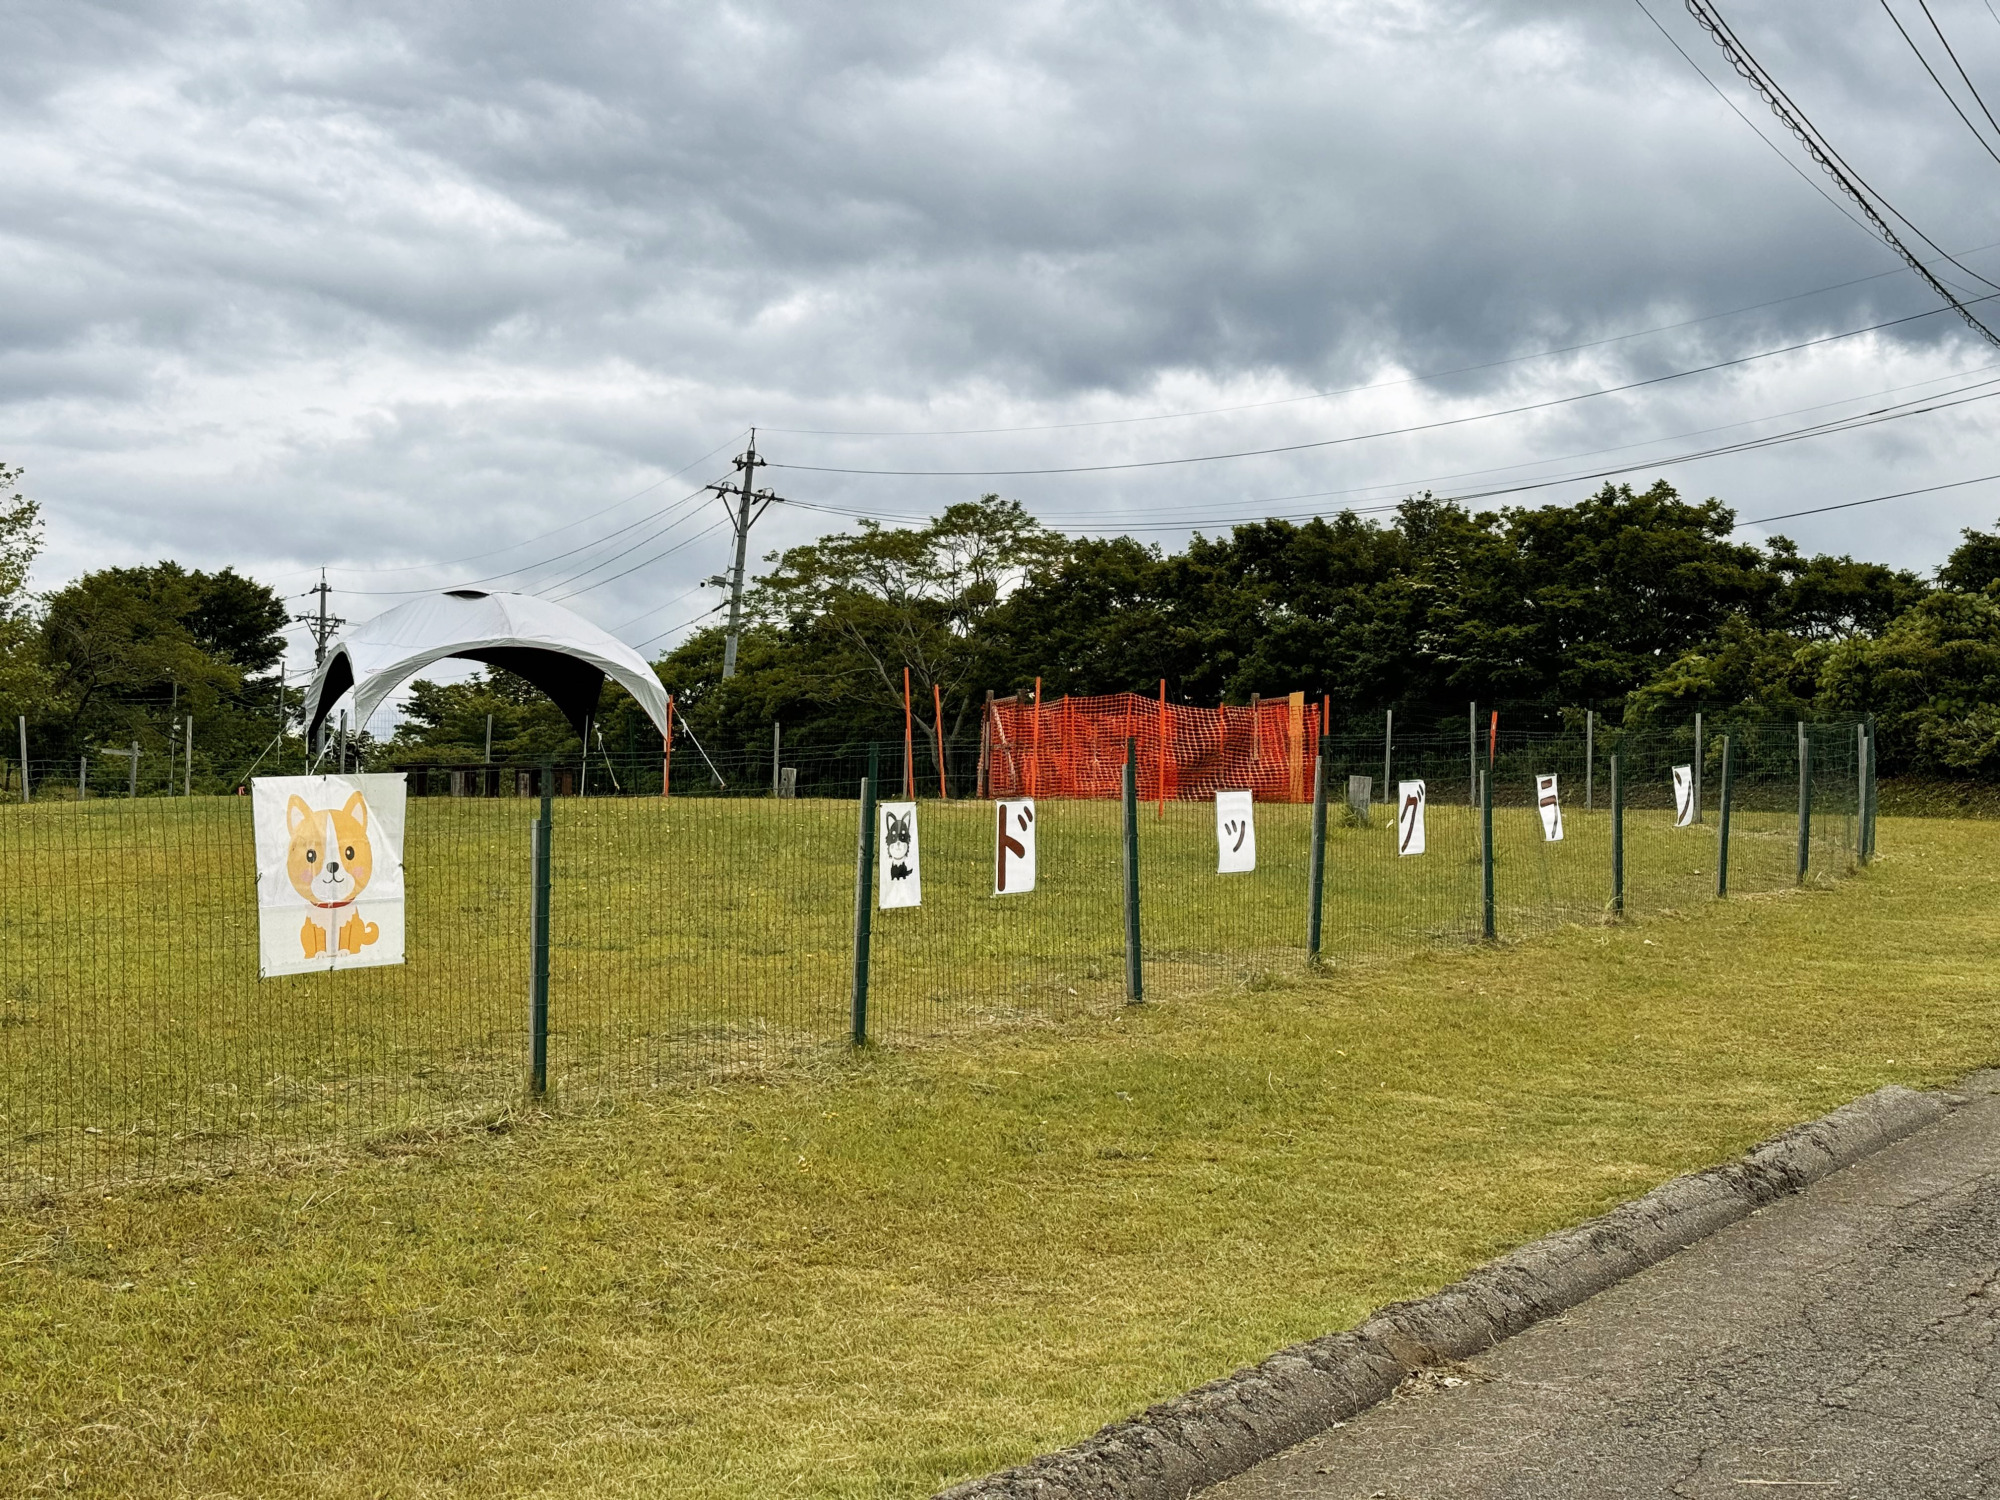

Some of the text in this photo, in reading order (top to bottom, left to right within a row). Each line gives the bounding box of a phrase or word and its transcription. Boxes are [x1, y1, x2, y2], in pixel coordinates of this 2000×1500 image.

[1401, 784, 1425, 853] グ
[1540, 778, 1559, 839] ラ
[1674, 771, 1692, 826] ン
[998, 804, 1034, 892] ド
